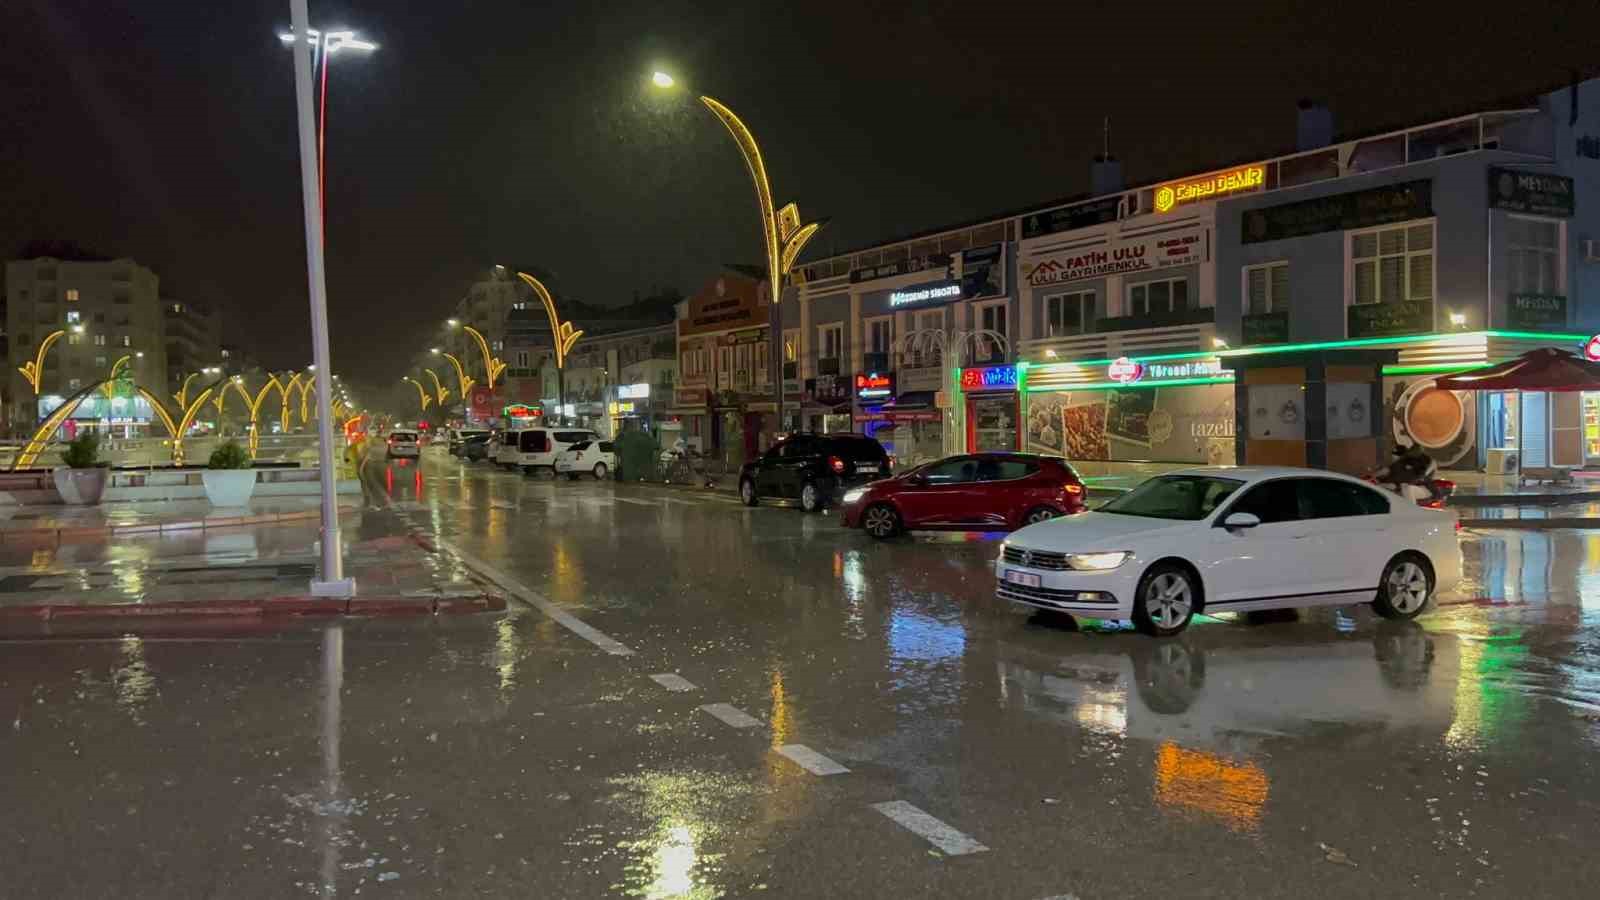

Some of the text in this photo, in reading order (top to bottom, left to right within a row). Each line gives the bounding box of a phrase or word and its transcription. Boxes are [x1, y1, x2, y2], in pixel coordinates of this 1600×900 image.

[1066, 252, 1107, 269] FATİH
[1113, 244, 1146, 261] ULU
[1035, 271, 1057, 284] ULU
